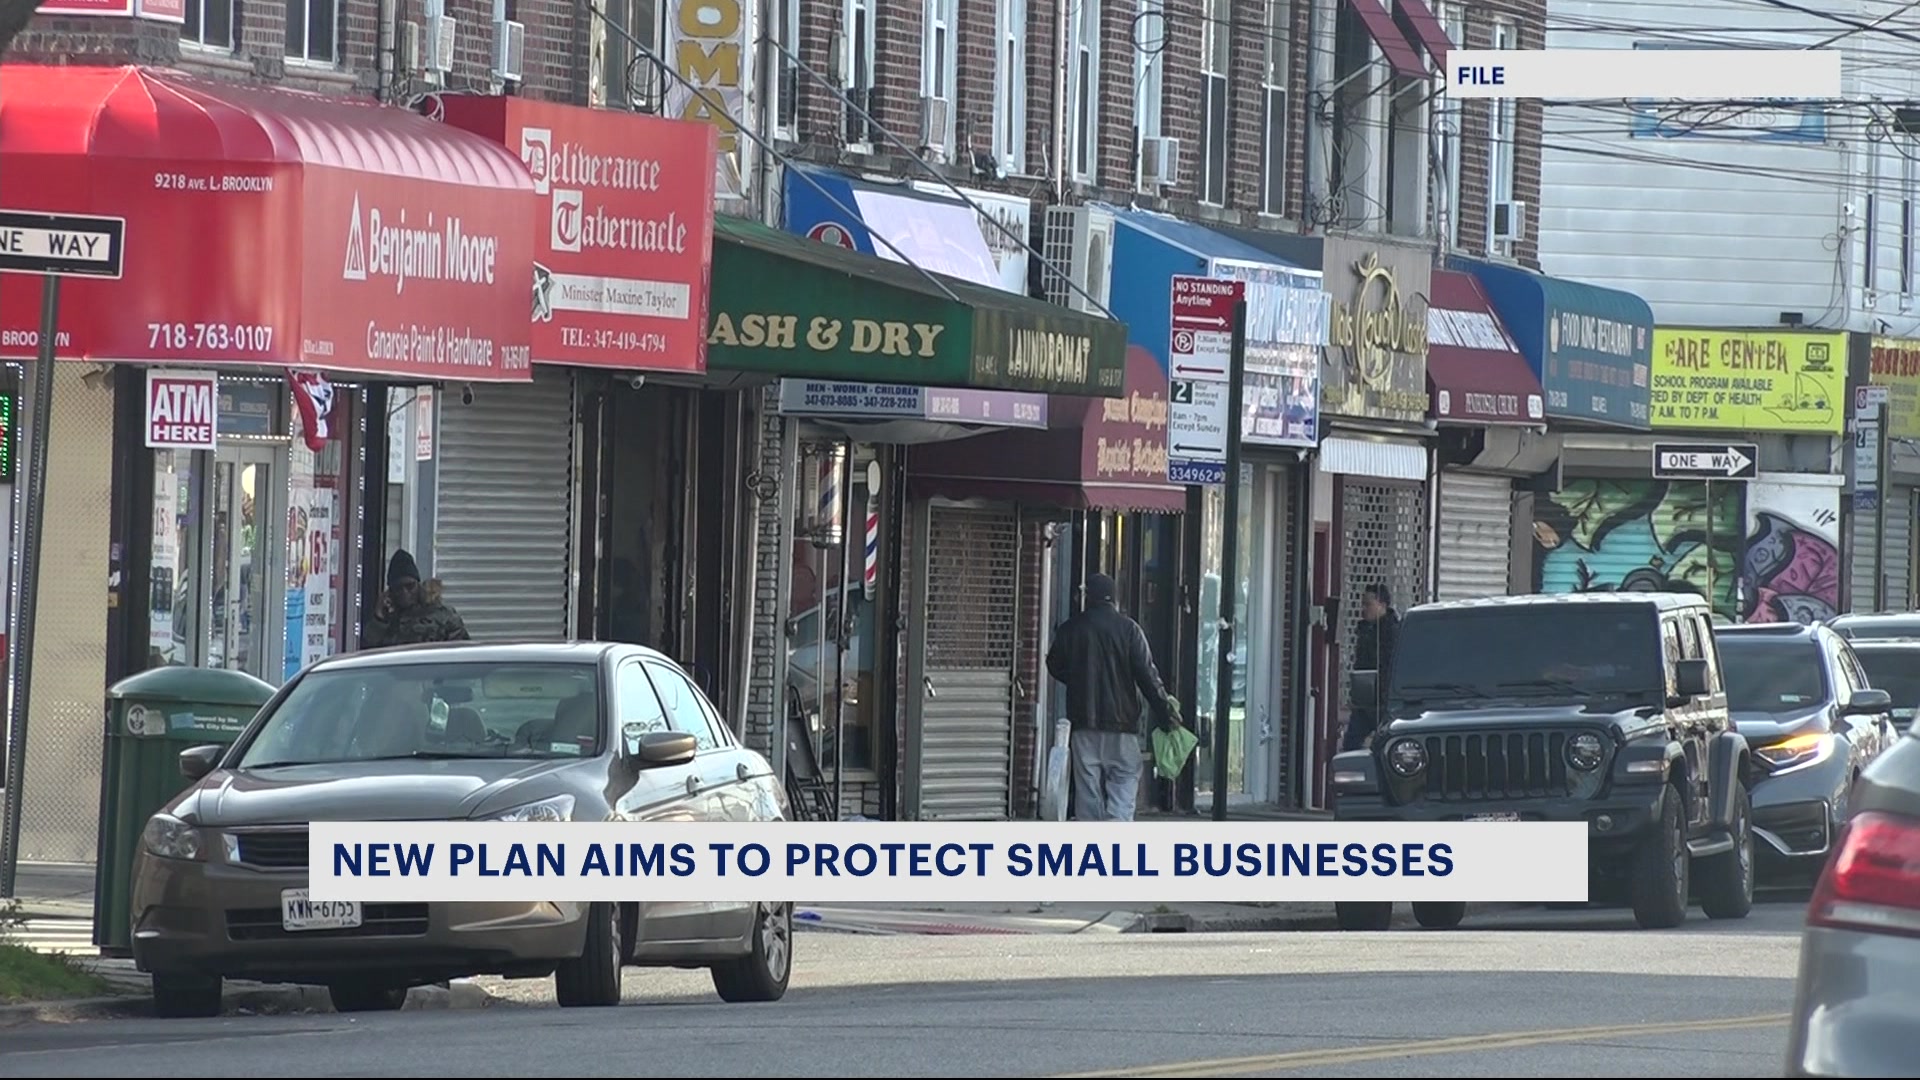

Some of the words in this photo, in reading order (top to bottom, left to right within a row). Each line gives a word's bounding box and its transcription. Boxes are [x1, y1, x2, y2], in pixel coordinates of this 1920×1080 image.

[525, 137, 660, 191] Deliverance
[155, 173, 186, 189] 9218
[222, 177, 273, 191] BROOKLYN
[557, 201, 686, 254] Tabernacle
[49, 233, 99, 257] WAY
[369, 208, 441, 295] Benjamin
[562, 285, 603, 302] Minister
[606, 288, 642, 305] Maxine
[646, 291, 676, 312] Taylor
[1176, 282, 1189, 292] NO
[1191, 283, 1234, 296] STANDING
[1176, 294, 1212, 307] Anytime
[148, 323, 273, 351] 718-763-0107
[561, 327, 591, 347] TEL:
[593, 330, 666, 352] 347-419-4794
[806, 316, 842, 351] &
[850, 320, 944, 357] DRY
[1562, 312, 1580, 347] FOOD
[367, 320, 408, 363] Canarsie
[410, 325, 436, 364] Paint
[437, 328, 444, 364] &
[446, 327, 492, 367] Hardware
[1008, 328, 1090, 384] LAUNDROMAT
[806, 383, 826, 393] MEN
[832, 384, 868, 394] WOMEN
[875, 386, 919, 396] CHILDREN
[1176, 381, 1187, 401] 2
[1653, 375, 1687, 388] SCHOOL
[1689, 376, 1729, 390] PROGRAM
[1731, 377, 1772, 391] AVAILABLE
[153, 384, 211, 423] ATM
[1672, 391, 1684, 403] BY
[1713, 392, 1726, 404] OF
[1729, 393, 1762, 405] HEALTH
[1679, 406, 1691, 419] TO
[1694, 406, 1700, 419] 7
[154, 426, 210, 442] HERE
[1669, 454, 1698, 468] ONE
[1712, 454, 1742, 468] WAY
[1170, 467, 1213, 482] 334962
